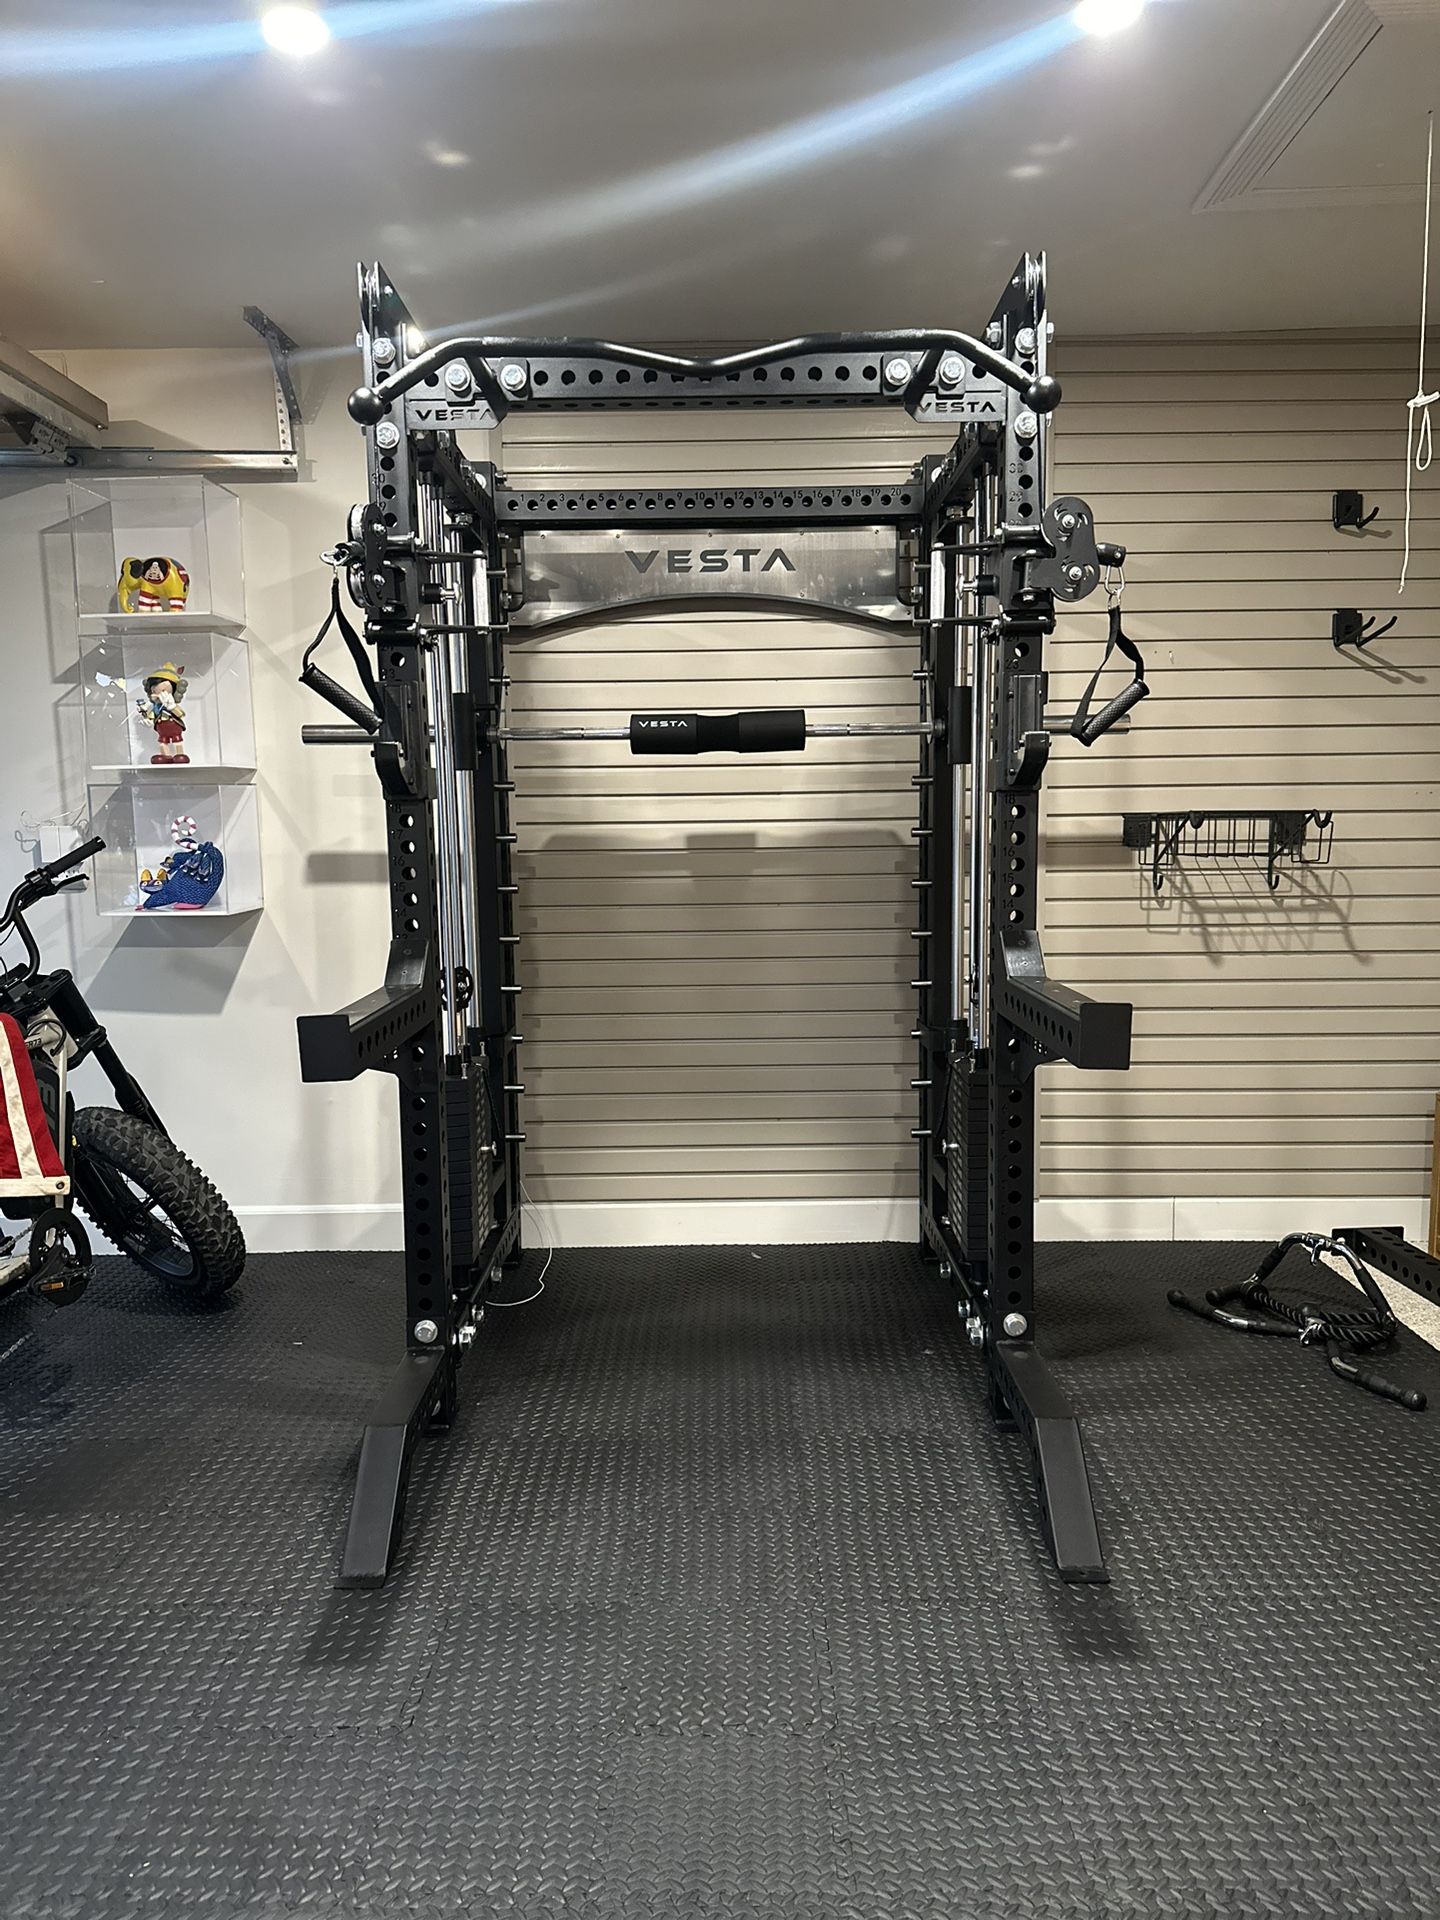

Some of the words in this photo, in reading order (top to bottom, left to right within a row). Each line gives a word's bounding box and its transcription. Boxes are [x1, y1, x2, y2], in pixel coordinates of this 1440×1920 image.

[919, 401, 997, 413] VESTA
[415, 408, 495, 421] VESTA
[520, 494, 525, 502] 1
[539, 493, 545, 502] 2
[559, 493, 565, 502] 3
[578, 493, 585, 501] 4
[598, 493, 604, 501] 5
[618, 492, 624, 501] 6
[638, 492, 644, 501] 7
[657, 492, 664, 501] 8
[676, 492, 683, 500] 9
[695, 491, 706, 500] 10
[714, 491, 724, 500] 11
[734, 491, 745, 500] 12
[754, 490, 764, 499] 13
[773, 490, 784, 499] 14
[793, 490, 803, 499] 15
[812, 490, 823, 498] 16
[831, 489, 842, 498] 17
[850, 489, 862, 497] 18
[870, 488, 881, 497] 19
[890, 487, 902, 496] 20
[624, 548, 796, 573] VESTA
[638, 720, 688, 728] VESTA
[1004, 794, 1016, 804] 18
[1003, 820, 1015, 830] 17
[1003, 846, 1015, 857] 16
[1002, 872, 1014, 883] 15
